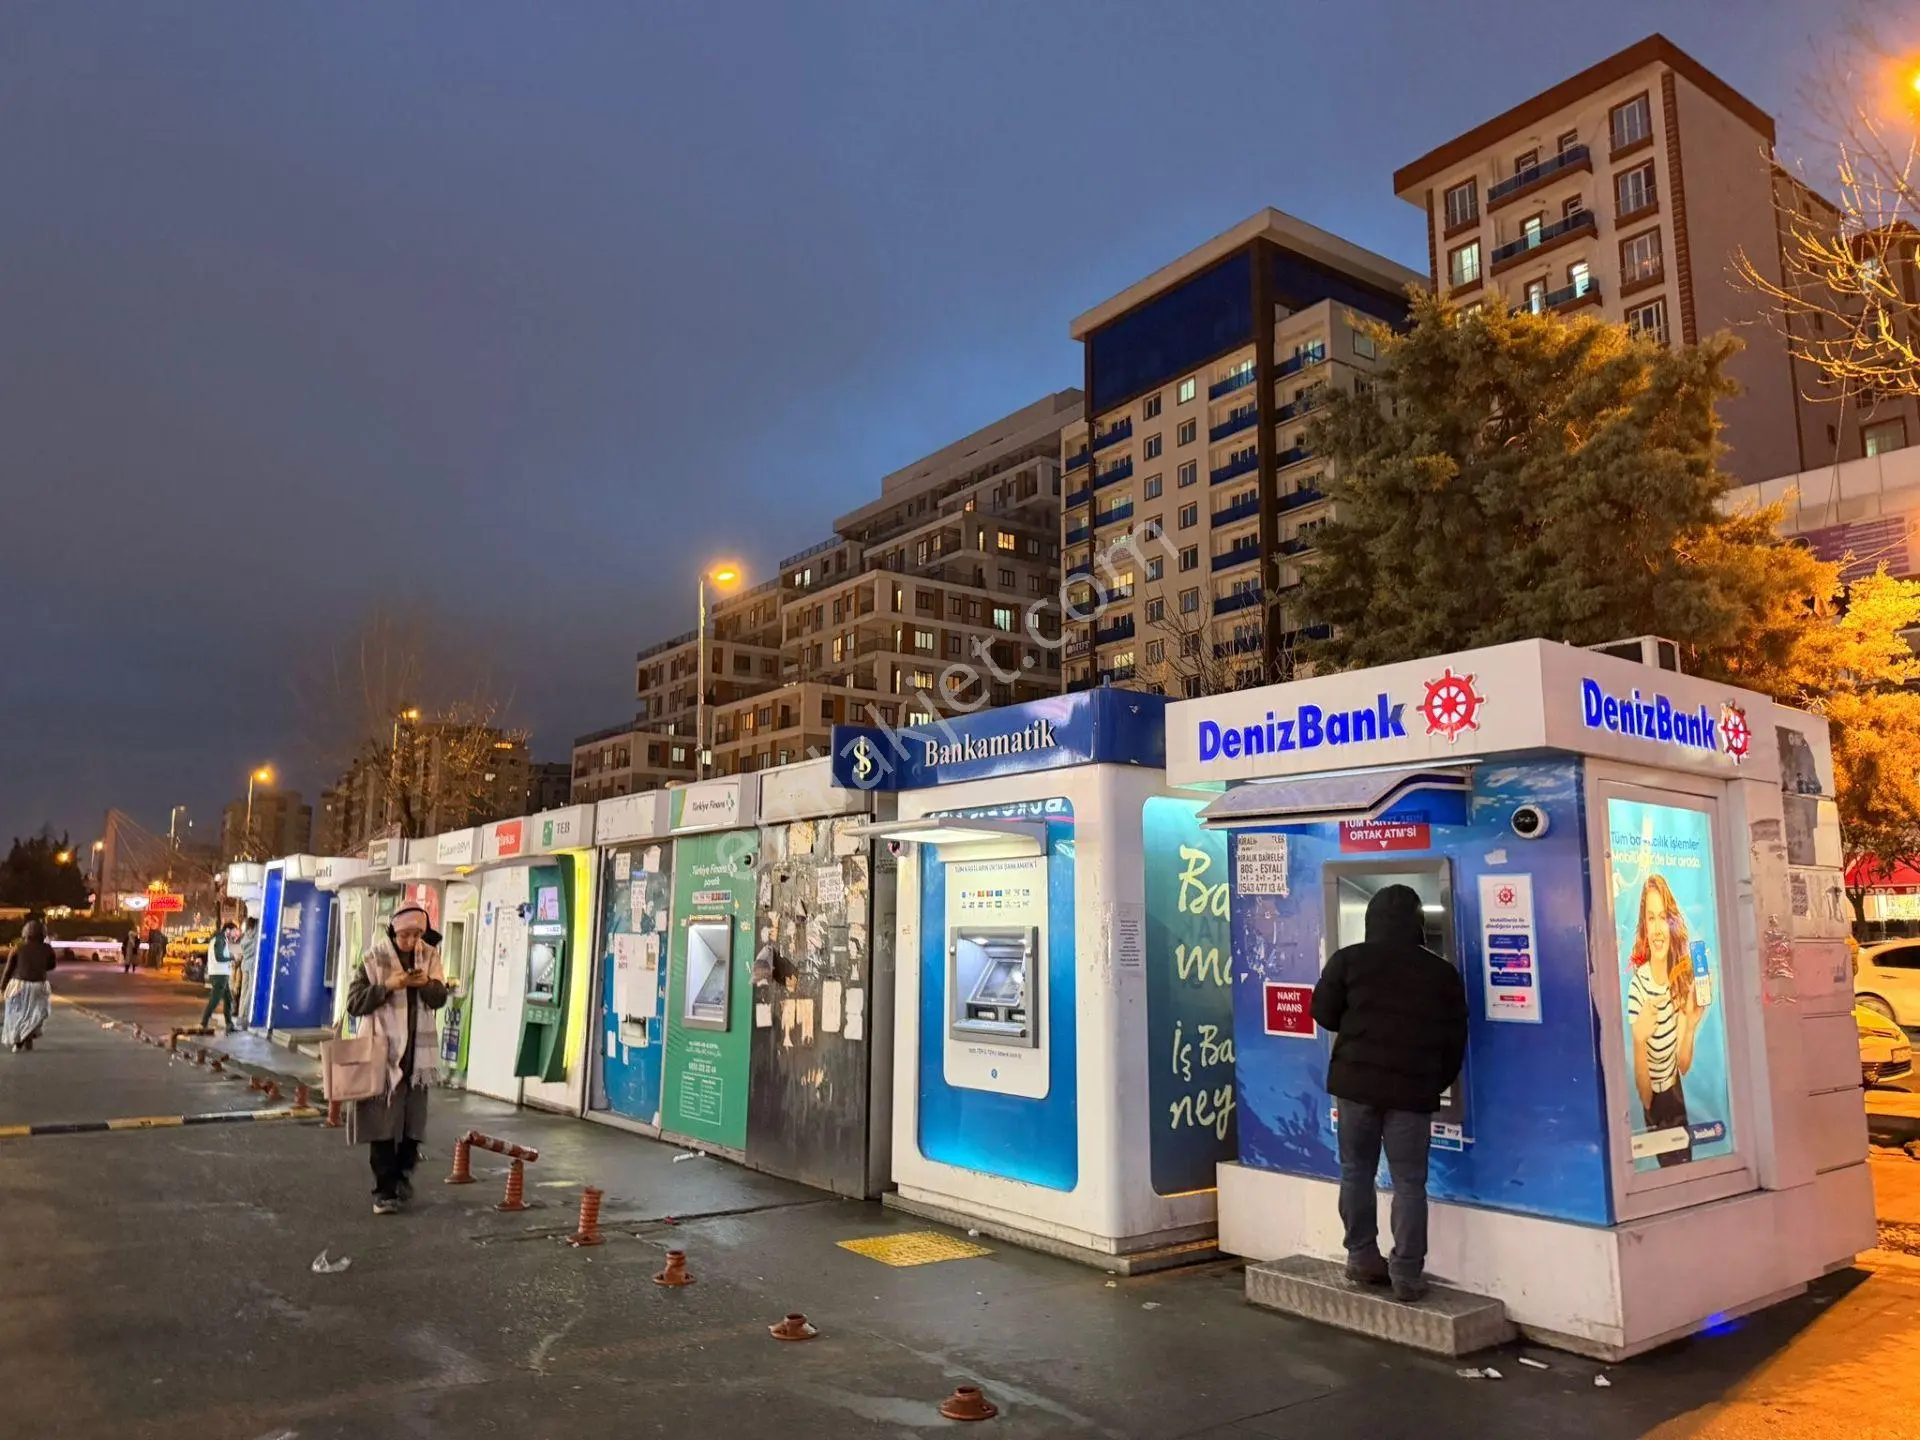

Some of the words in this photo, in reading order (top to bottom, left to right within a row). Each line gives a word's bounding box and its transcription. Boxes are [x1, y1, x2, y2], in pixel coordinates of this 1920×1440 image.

[1581, 677, 1717, 752] DenizBank
[1197, 692, 1408, 763] DenizBank
[924, 718, 1057, 768] Bankamatik
[557, 821, 570, 834] TEB
[1350, 829, 1383, 841] ORTAK
[1277, 990, 1301, 1002] NAKİT
[1276, 1002, 1303, 1014] AVANS
